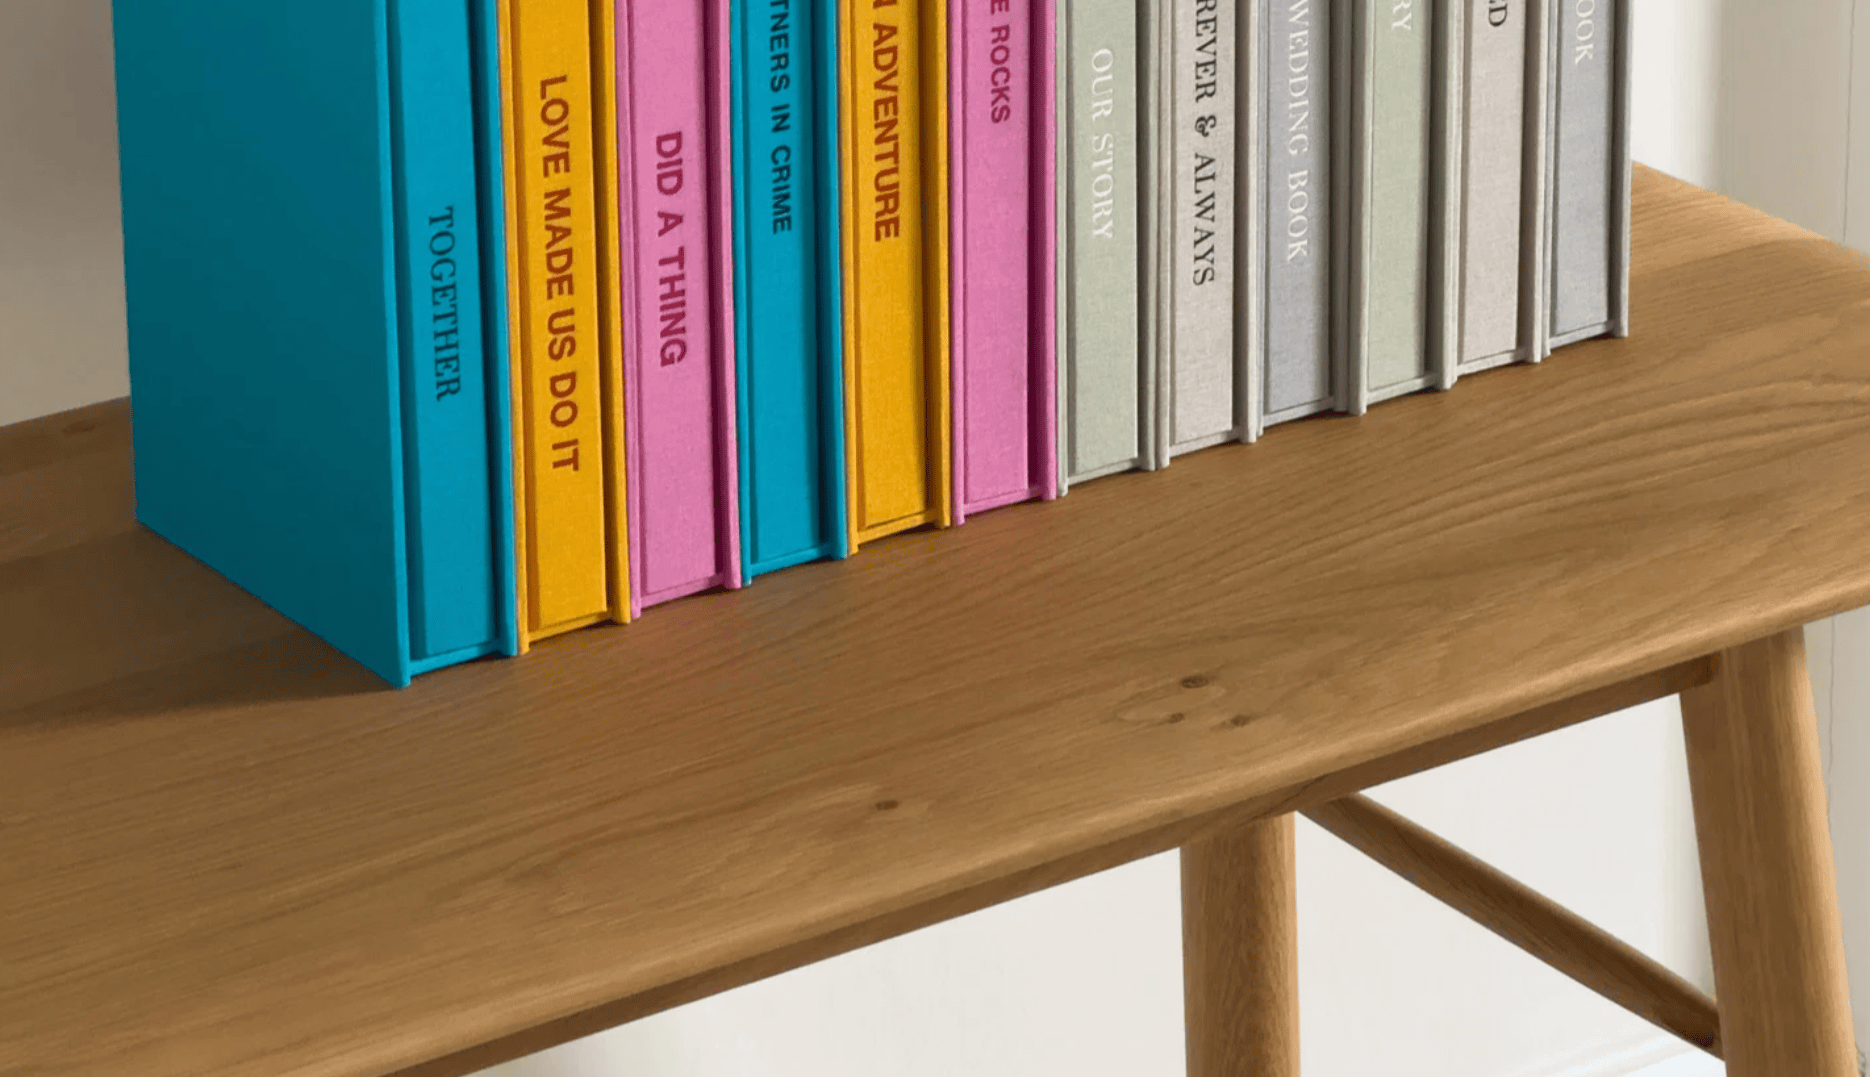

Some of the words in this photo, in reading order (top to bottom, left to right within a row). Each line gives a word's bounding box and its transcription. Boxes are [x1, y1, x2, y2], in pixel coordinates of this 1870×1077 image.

[771, 103, 790, 133] IN
[990, 23, 1011, 124] ROCKS
[1091, 48, 1113, 121] OUR
[540, 74, 570, 178] LOVE
[656, 131, 684, 196] DID
[873, 22, 899, 242] ADVENTURE
[1194, 114, 1216, 138] &
[657, 211, 683, 238] A
[771, 144, 792, 235] CRIME
[1092, 133, 1114, 240] STORY
[1193, 153, 1216, 287] ALWAYS
[1287, 170, 1309, 263] BOOK
[544, 187, 574, 300] MADE
[428, 205, 461, 402] TOGETHER
[547, 308, 576, 362] US
[659, 246, 687, 368] THING
[549, 371, 578, 428] DO
[552, 438, 579, 472] IT
